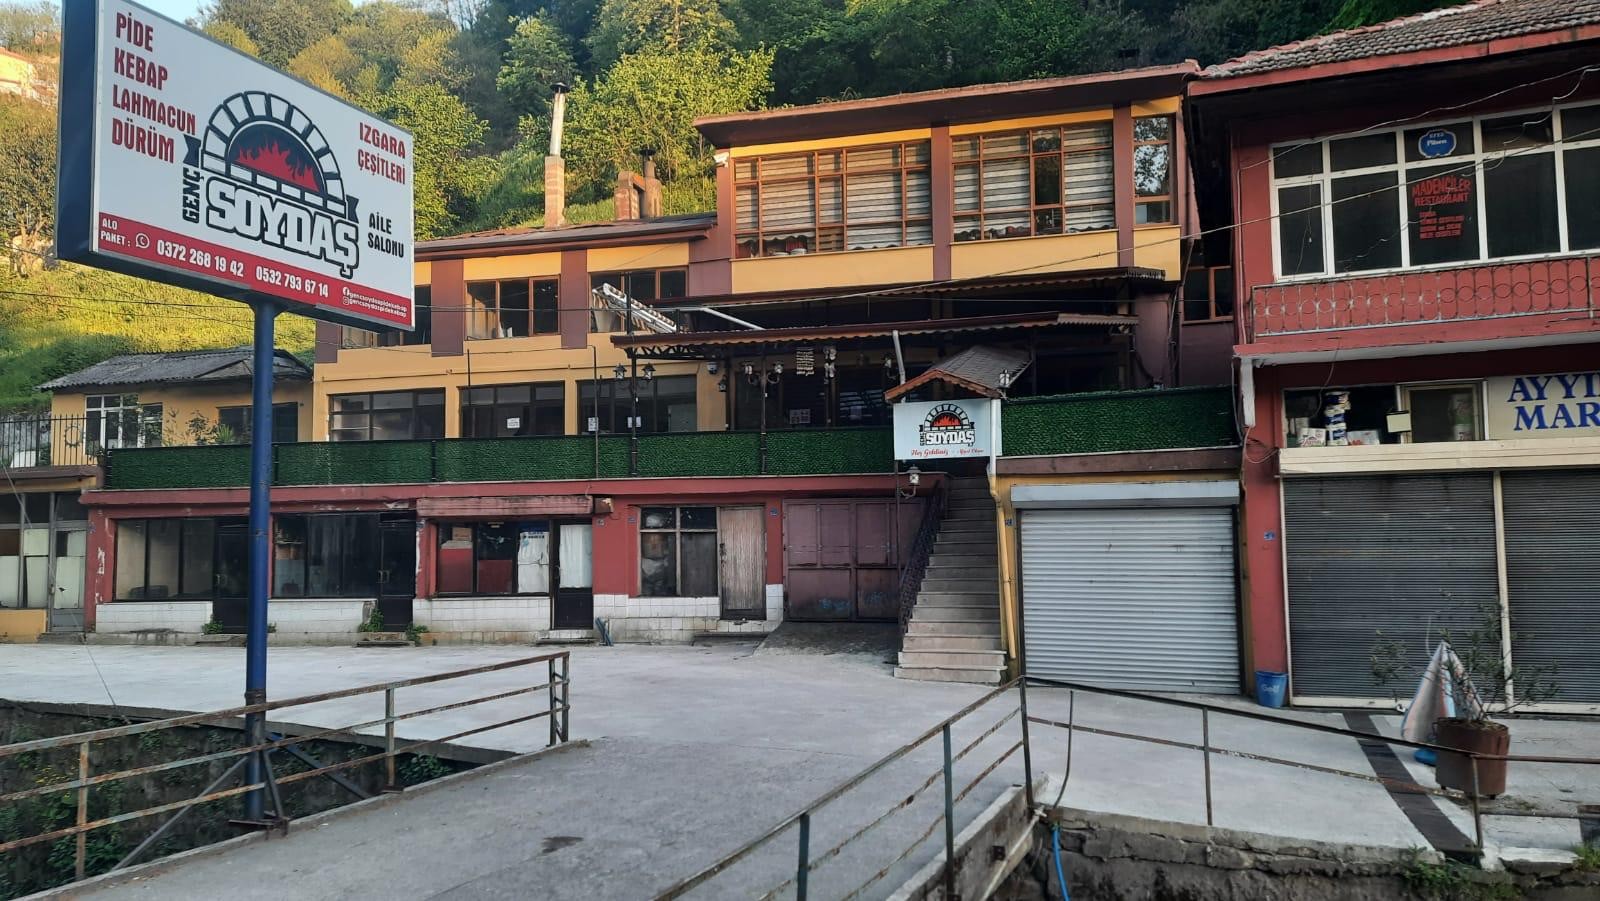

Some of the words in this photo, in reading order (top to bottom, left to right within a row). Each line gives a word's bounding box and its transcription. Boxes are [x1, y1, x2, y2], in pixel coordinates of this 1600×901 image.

[116, 12, 154, 52] PİDE
[114, 47, 168, 91] KEBAP
[112, 84, 196, 136] LAHMACUN
[112, 117, 174, 164] DÜRÜM
[360, 122, 406, 159] IZGARA
[358, 148, 406, 185] ÇEŞİTLERİ
[182, 167, 204, 224] GENÇ
[100, 230, 126, 246] PAKET
[102, 218, 118, 230] ALO
[206, 176, 360, 280] SOYDAŞ
[368, 211, 392, 235] AİLE
[157, 239, 187, 262] 0372
[189, 248, 211, 268] 268
[214, 255, 227, 273] 19
[230, 260, 244, 278] 42
[367, 232, 404, 258] SALONU
[256, 265, 282, 286] 0532
[284, 273, 301, 291] 793
[304, 279, 316, 295] 67
[318, 282, 329, 298] 14
[1507, 372, 1600, 402] AYYI
